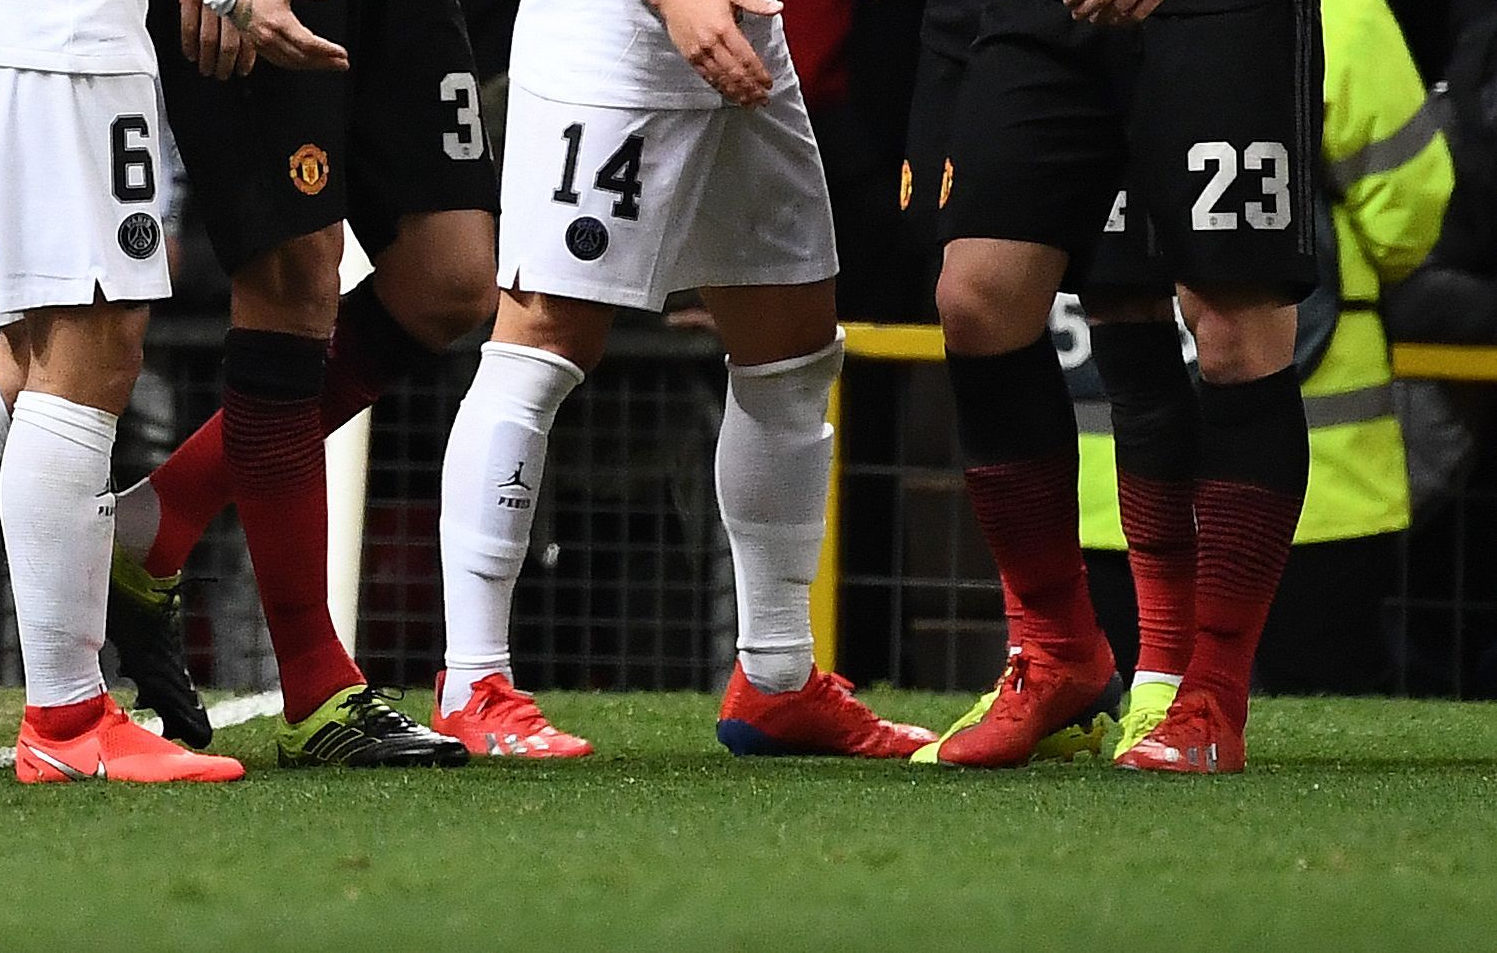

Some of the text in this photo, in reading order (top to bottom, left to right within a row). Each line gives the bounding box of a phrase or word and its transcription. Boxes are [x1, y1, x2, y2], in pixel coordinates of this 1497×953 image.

[110, 113, 155, 204] 6
[439, 71, 495, 162] 3
[551, 121, 645, 222] 14
[1187, 141, 1292, 231] 23
